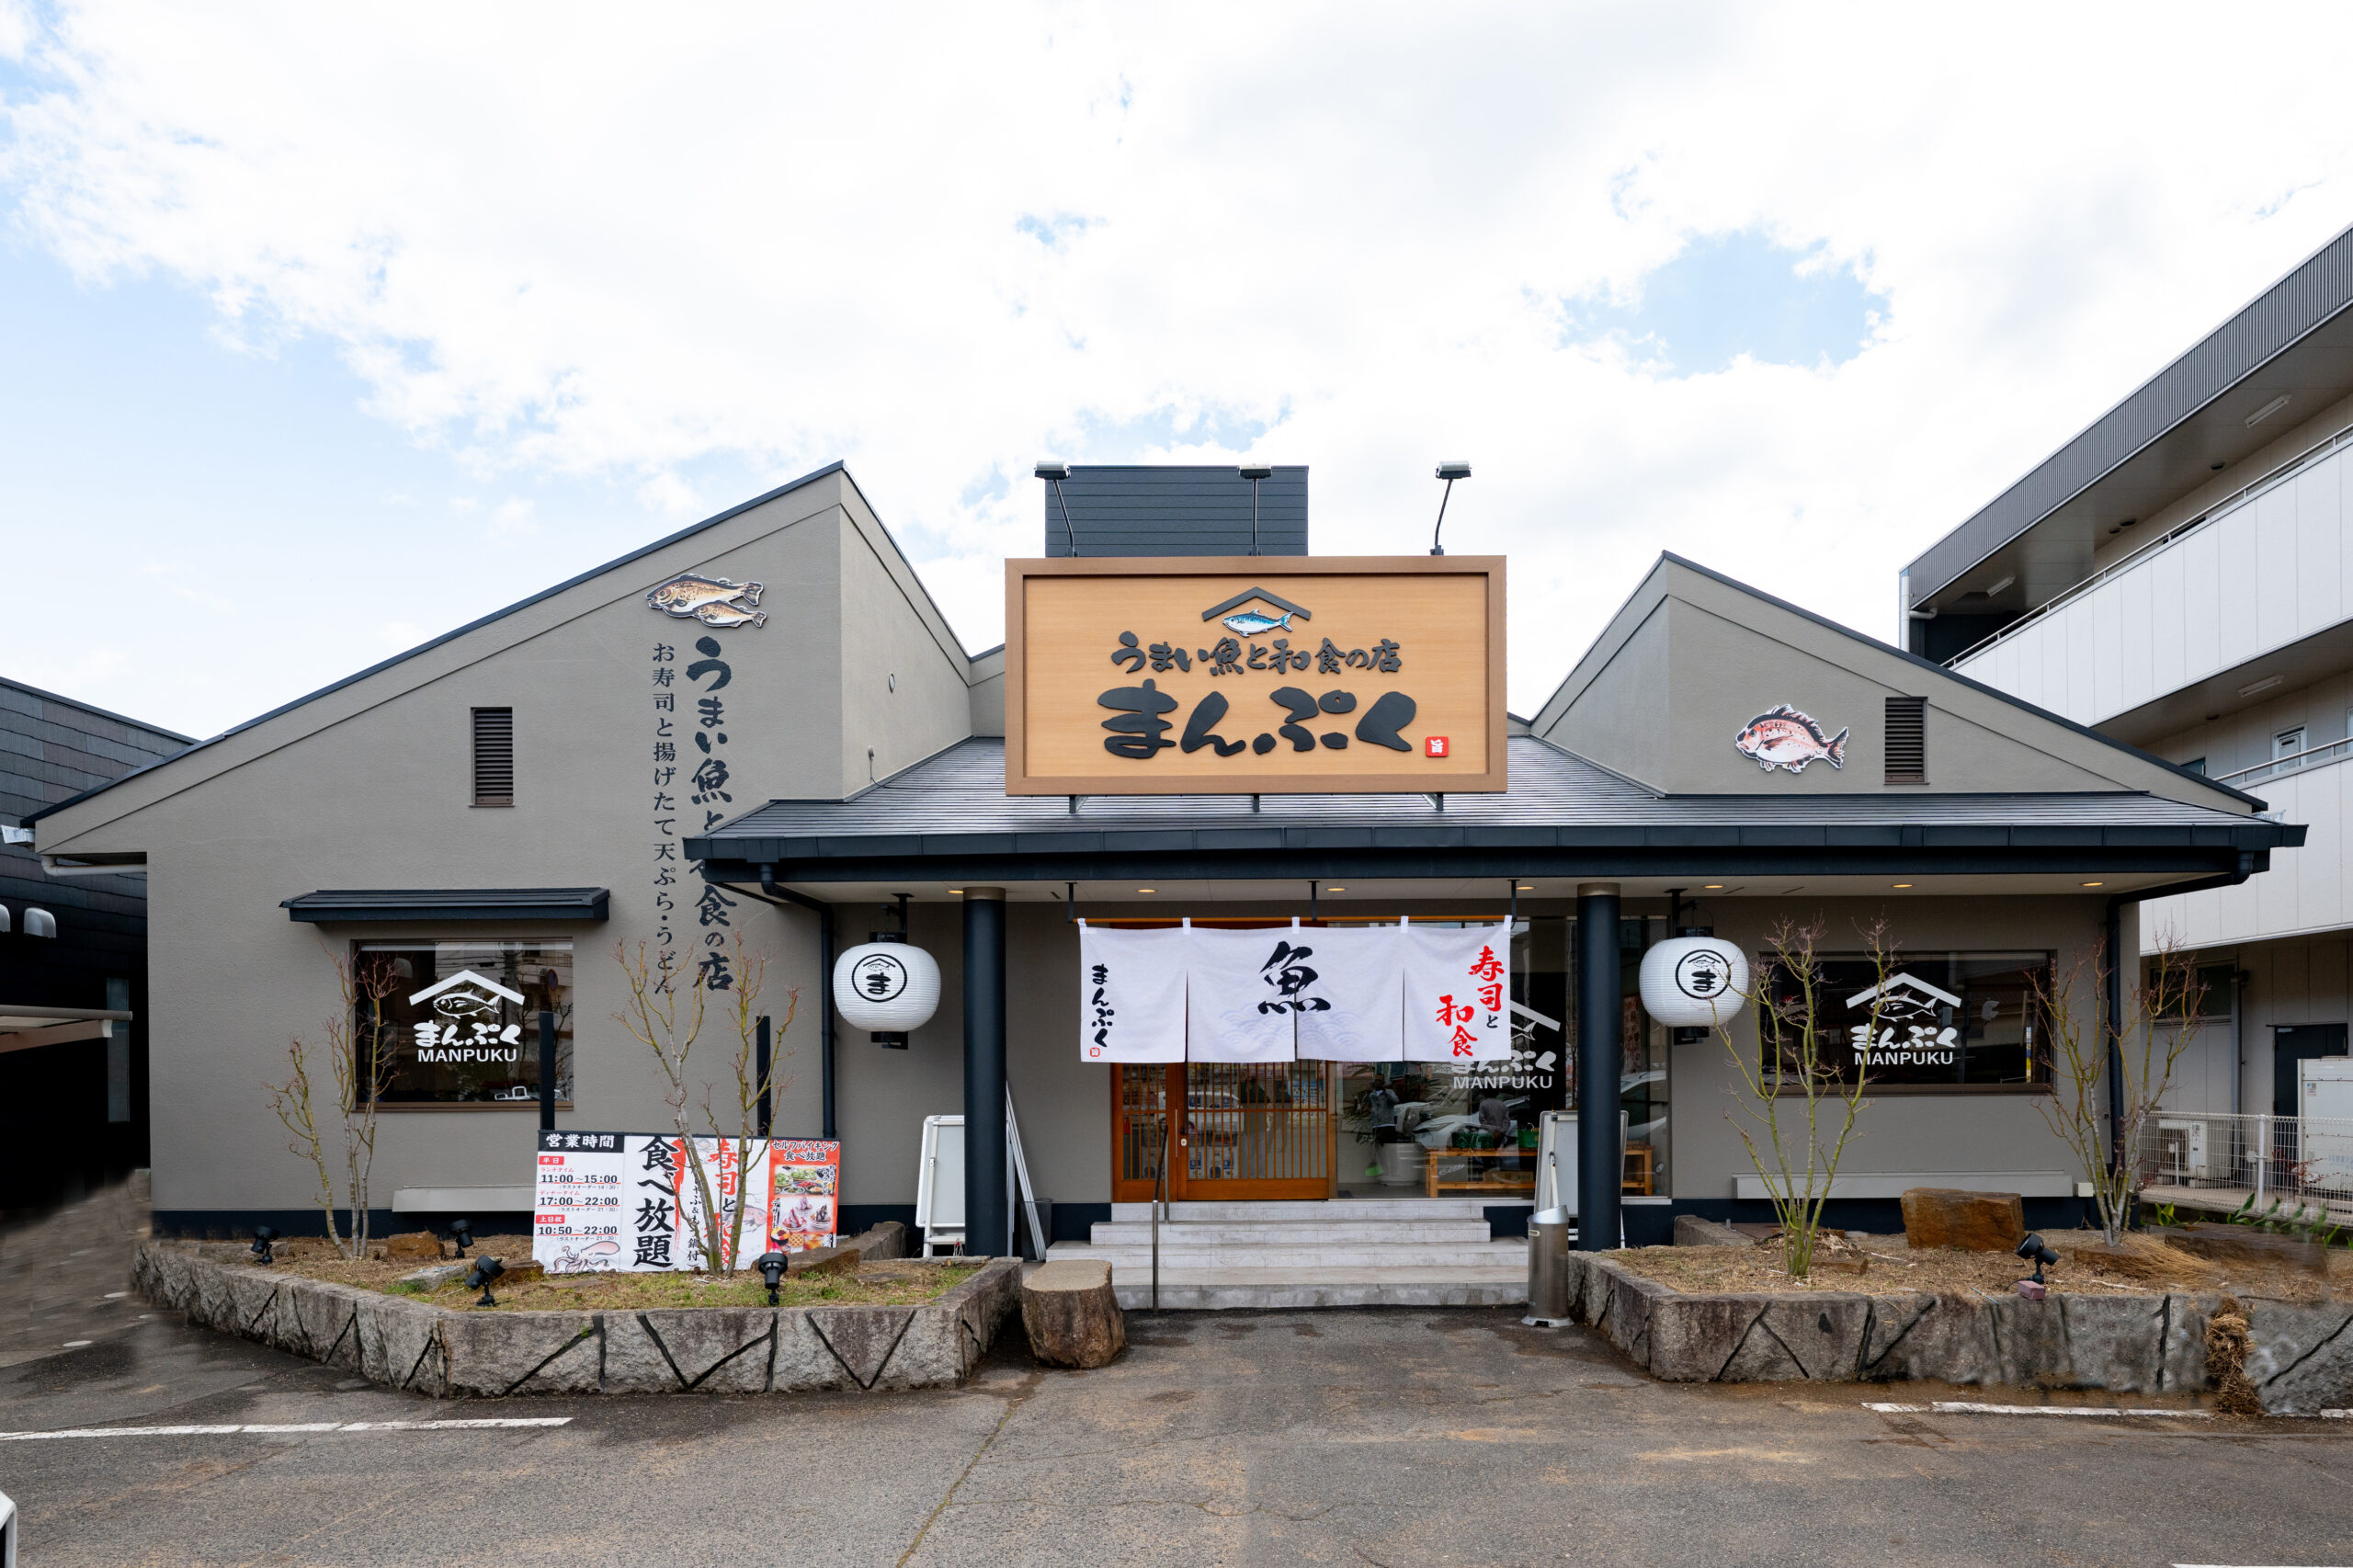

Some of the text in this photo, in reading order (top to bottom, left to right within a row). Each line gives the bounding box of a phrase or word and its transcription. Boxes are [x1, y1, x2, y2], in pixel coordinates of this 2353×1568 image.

[1110, 631, 1403, 676] うまい魚と和食の店
[1097, 678, 1416, 759] まんぷく
[686, 636, 737, 992] うまい魚と食の店
[1258, 940, 1332, 1016] 魚
[1468, 945, 1505, 1029] 寿司と
[1091, 963, 1115, 1048] まんぷく
[414, 1019, 521, 1047] まんぷく
[1436, 994, 1479, 1057] 和食
[1849, 1023, 1958, 1051] まんぷく
[418, 1049, 517, 1062] MANPUKU
[1854, 1051, 1953, 1065] MANPUKU
[1453, 1075, 1552, 1089] MANPUKU
[546, 1132, 615, 1149] 営業時間
[772, 1140, 840, 1152] セルフバイキング
[784, 1150, 827, 1161] 食べ放題
[632, 1135, 679, 1268] 食べ放題
